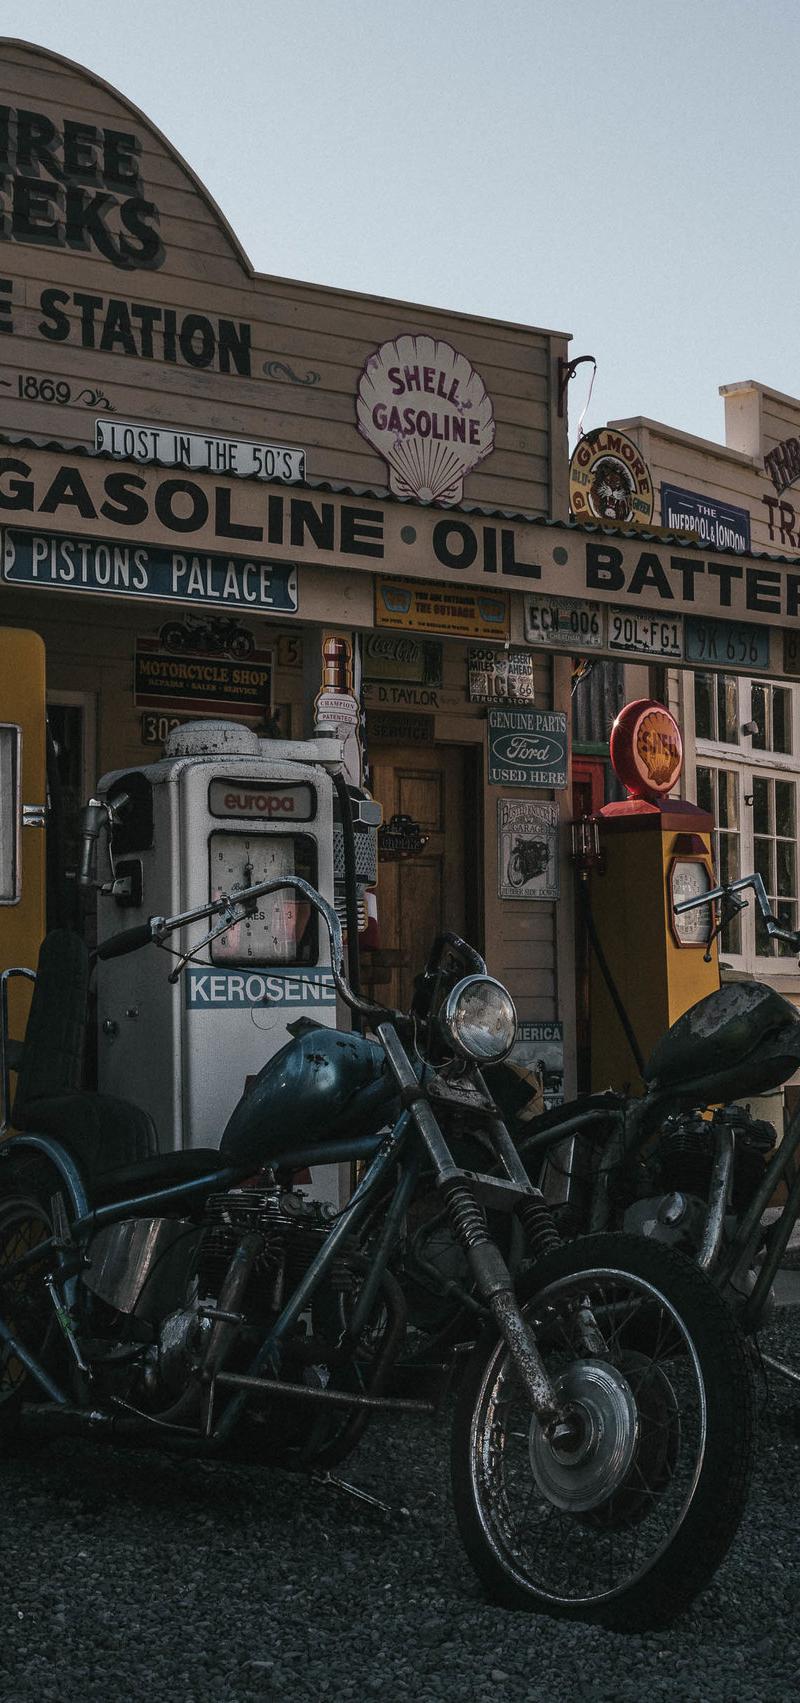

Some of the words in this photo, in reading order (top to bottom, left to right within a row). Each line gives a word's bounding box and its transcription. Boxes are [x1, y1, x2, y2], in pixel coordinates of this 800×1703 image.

[38, 288, 251, 376] STATION
[18, 375, 71, 404] 1869
[388, 365, 460, 407] SHELL
[372, 403, 481, 445] GASOLINE
[111, 427, 160, 458] LOST
[174, 436, 191, 465] IN
[205, 440, 238, 472] THE
[252, 447, 292, 480] 50'S
[577, 434, 649, 494] GILMORE
[0, 457, 384, 558] GASOLINE
[432, 520, 541, 579] OIL
[697, 504, 716, 518] THE
[761, 494, 800, 548] TR
[31, 537, 150, 590] PISTONS
[171, 553, 274, 603] PALACE
[415, 603, 432, 613] THE
[570, 611, 598, 634] 006
[469, 650, 494, 661] 500
[469, 660, 495, 673] MILES
[508, 653, 532, 665] DESERT
[139, 658, 229, 683] MOTORCYCLE
[232, 669, 269, 687] SHOP
[508, 663, 532, 675] AHEAD
[320, 700, 355, 709] CHAMPION
[391, 688, 440, 708] TAYLOR
[322, 713, 353, 722] PATENTED
[489, 711, 534, 730] GENUINE
[536, 716, 567, 733] PARTS
[506, 736, 551, 761] Ford
[642, 730, 679, 758] SHELL
[491, 768, 527, 781] USED
[530, 770, 566, 784] HERE
[224, 793, 294, 817] europa
[190, 974, 337, 1002] KEROSENE
